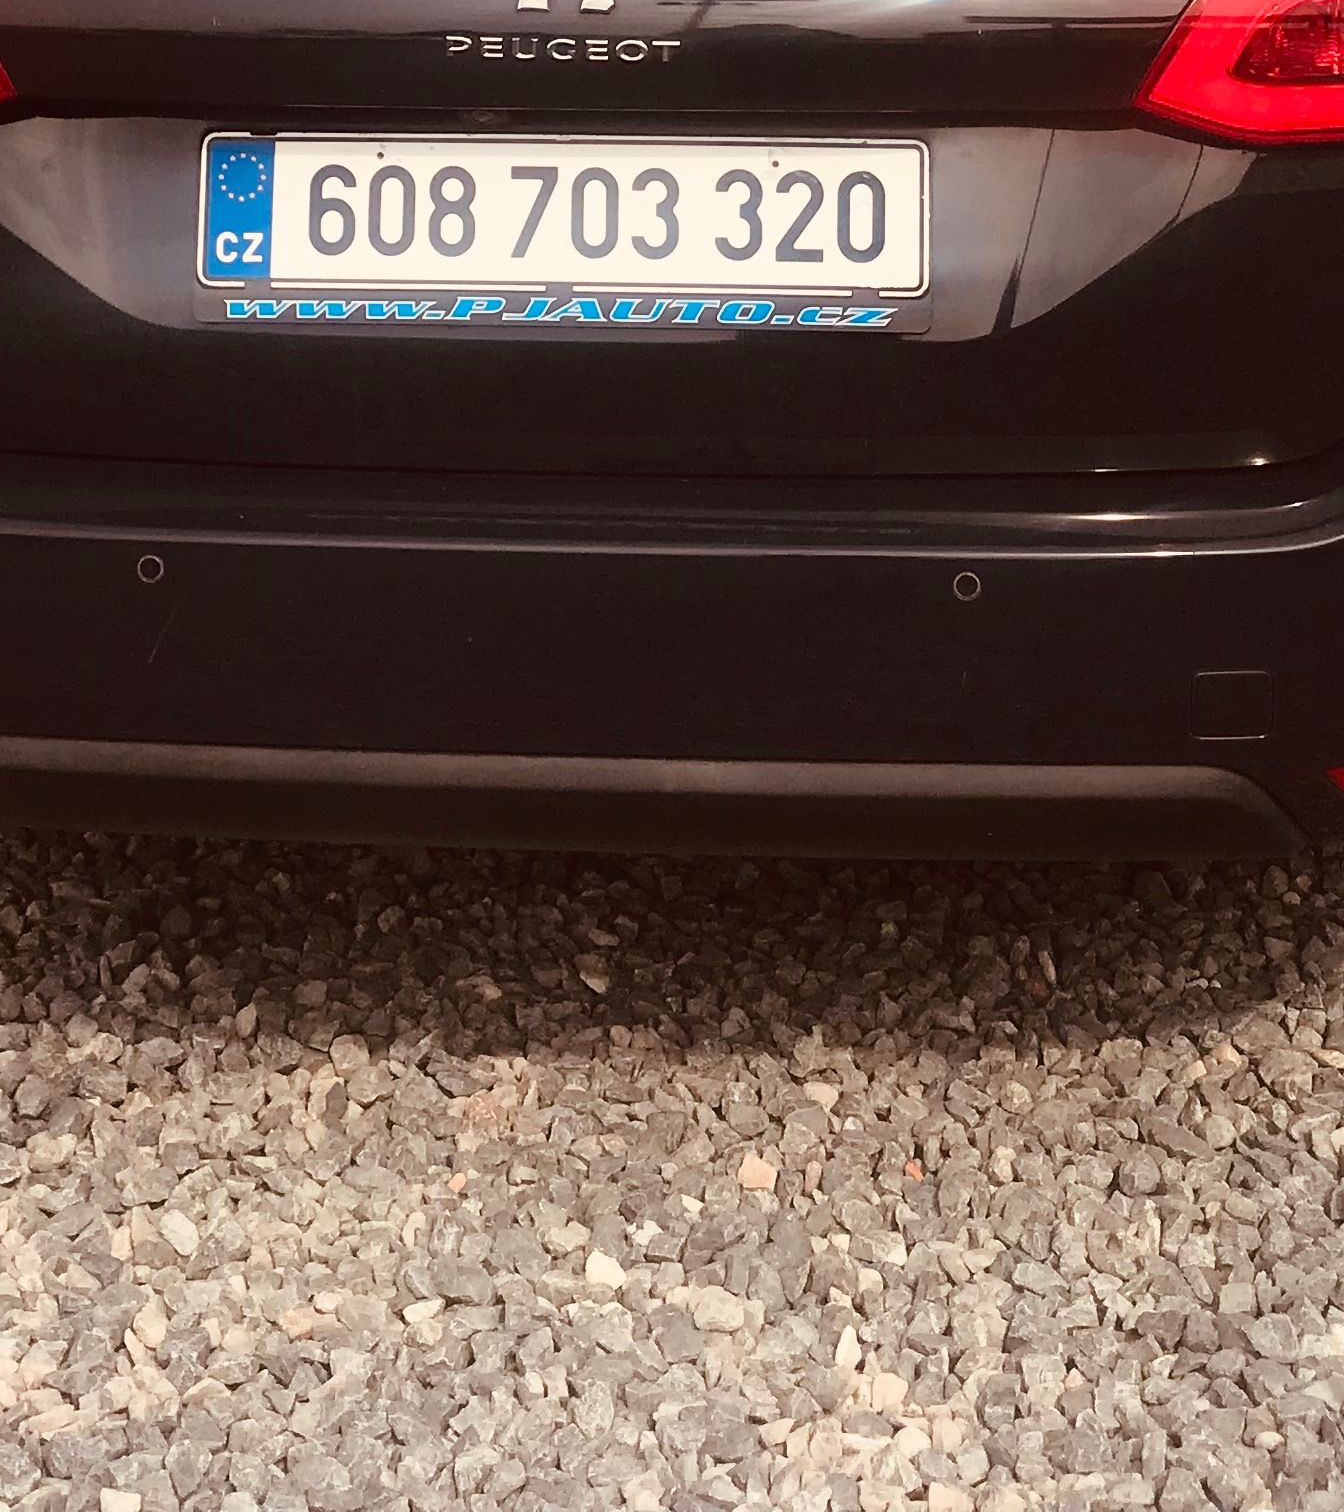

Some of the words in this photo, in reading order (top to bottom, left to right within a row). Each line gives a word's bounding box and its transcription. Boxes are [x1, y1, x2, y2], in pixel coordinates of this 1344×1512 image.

[445, 35, 681, 63] PEUGEOT
[216, 231, 264, 263] CZ
[308, 164, 476, 257] 608
[509, 166, 681, 260] 703
[714, 169, 887, 263] 320
